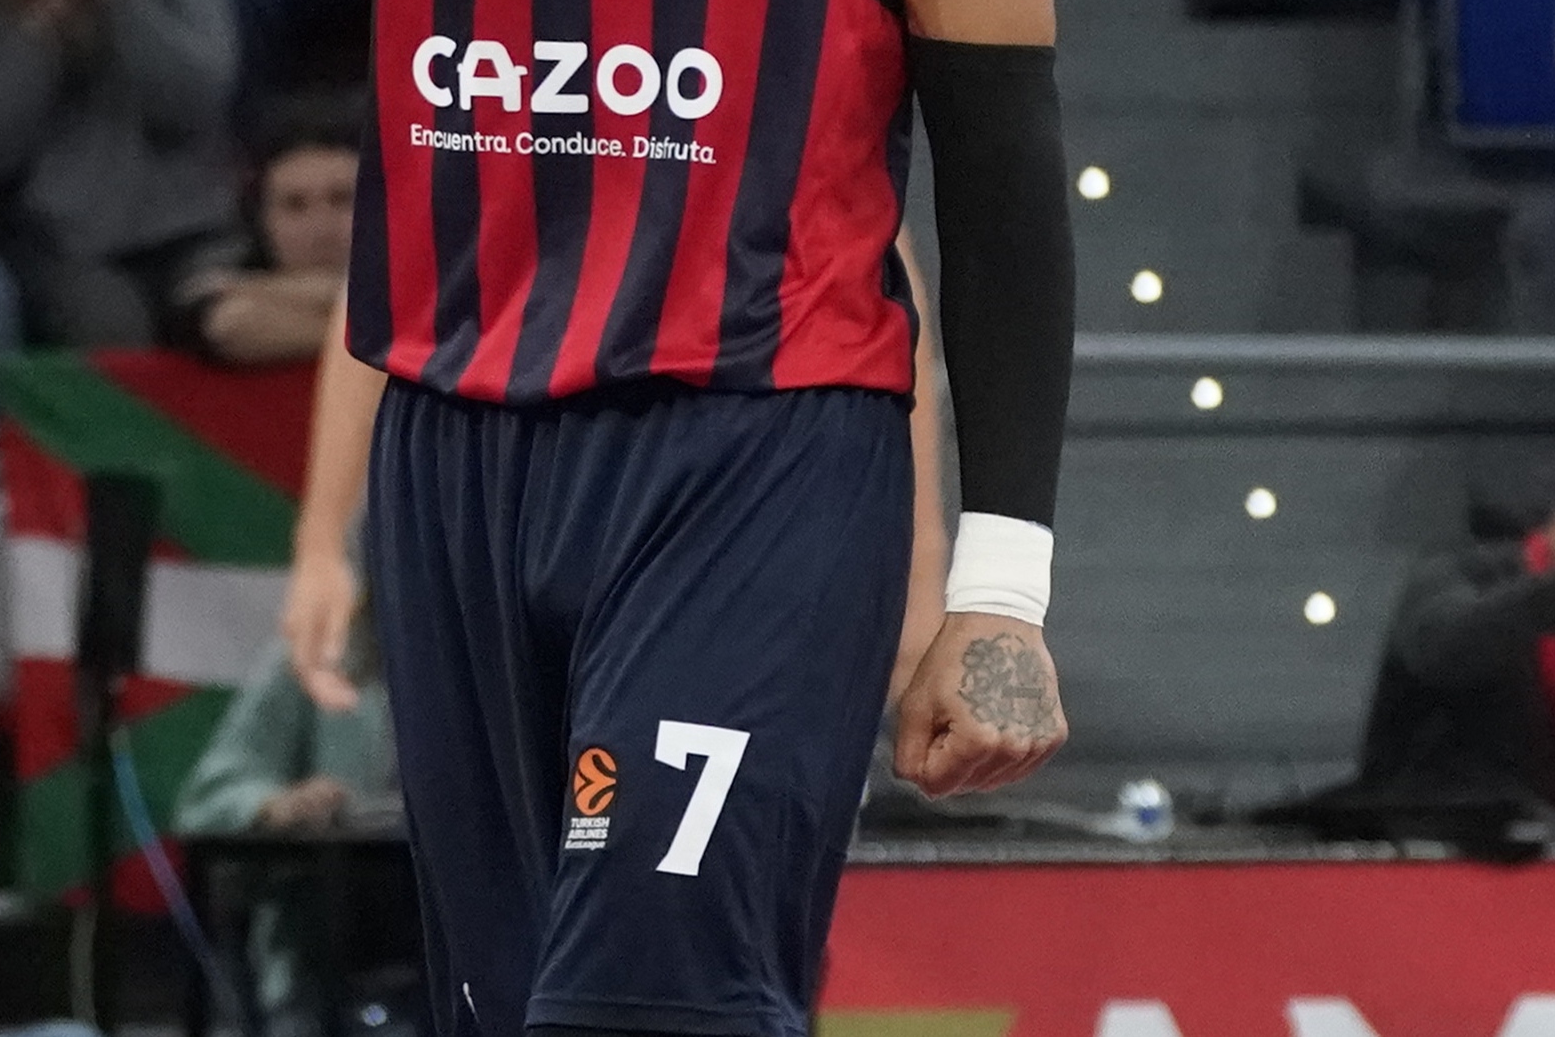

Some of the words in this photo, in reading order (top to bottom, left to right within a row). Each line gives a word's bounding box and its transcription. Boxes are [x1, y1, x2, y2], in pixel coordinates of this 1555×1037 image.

[412, 35, 723, 120] CAZOO
[410, 123, 512, 153] Encuentra.
[515, 131, 627, 157] Conduce.
[632, 135, 717, 164] Disfruta.
[654, 719, 752, 877] 7
